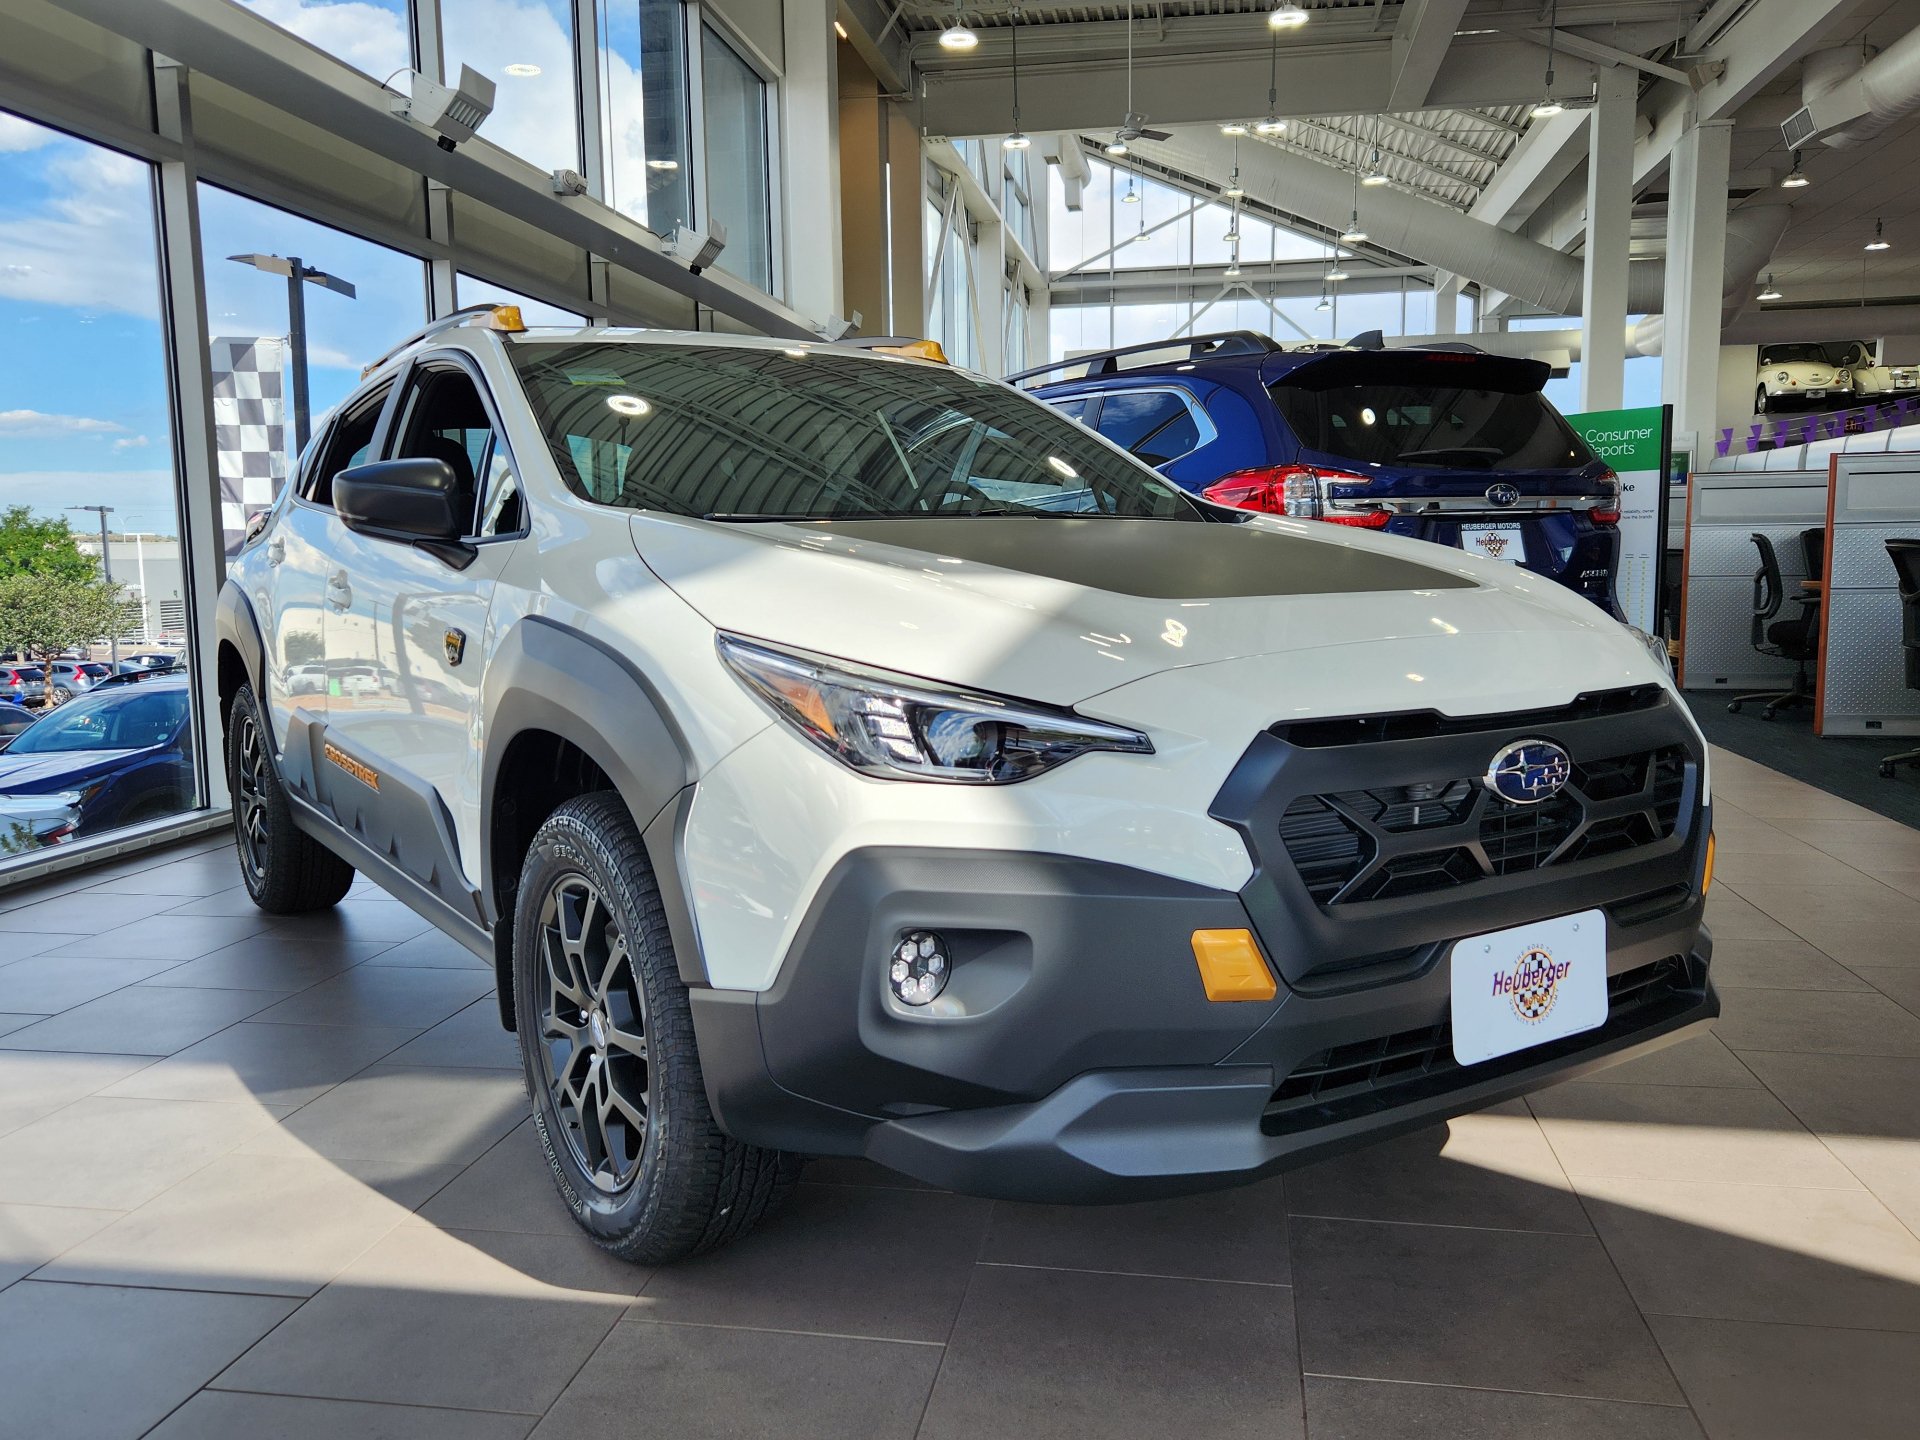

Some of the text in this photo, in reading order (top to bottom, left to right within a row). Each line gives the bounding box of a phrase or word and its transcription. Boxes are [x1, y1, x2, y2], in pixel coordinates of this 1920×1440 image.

[1586, 428, 1653, 443] Consumer
[1620, 483, 1635, 492] ke
[1476, 535, 1508, 547] Heuberger
[1492, 960, 1571, 996] Heuberger
